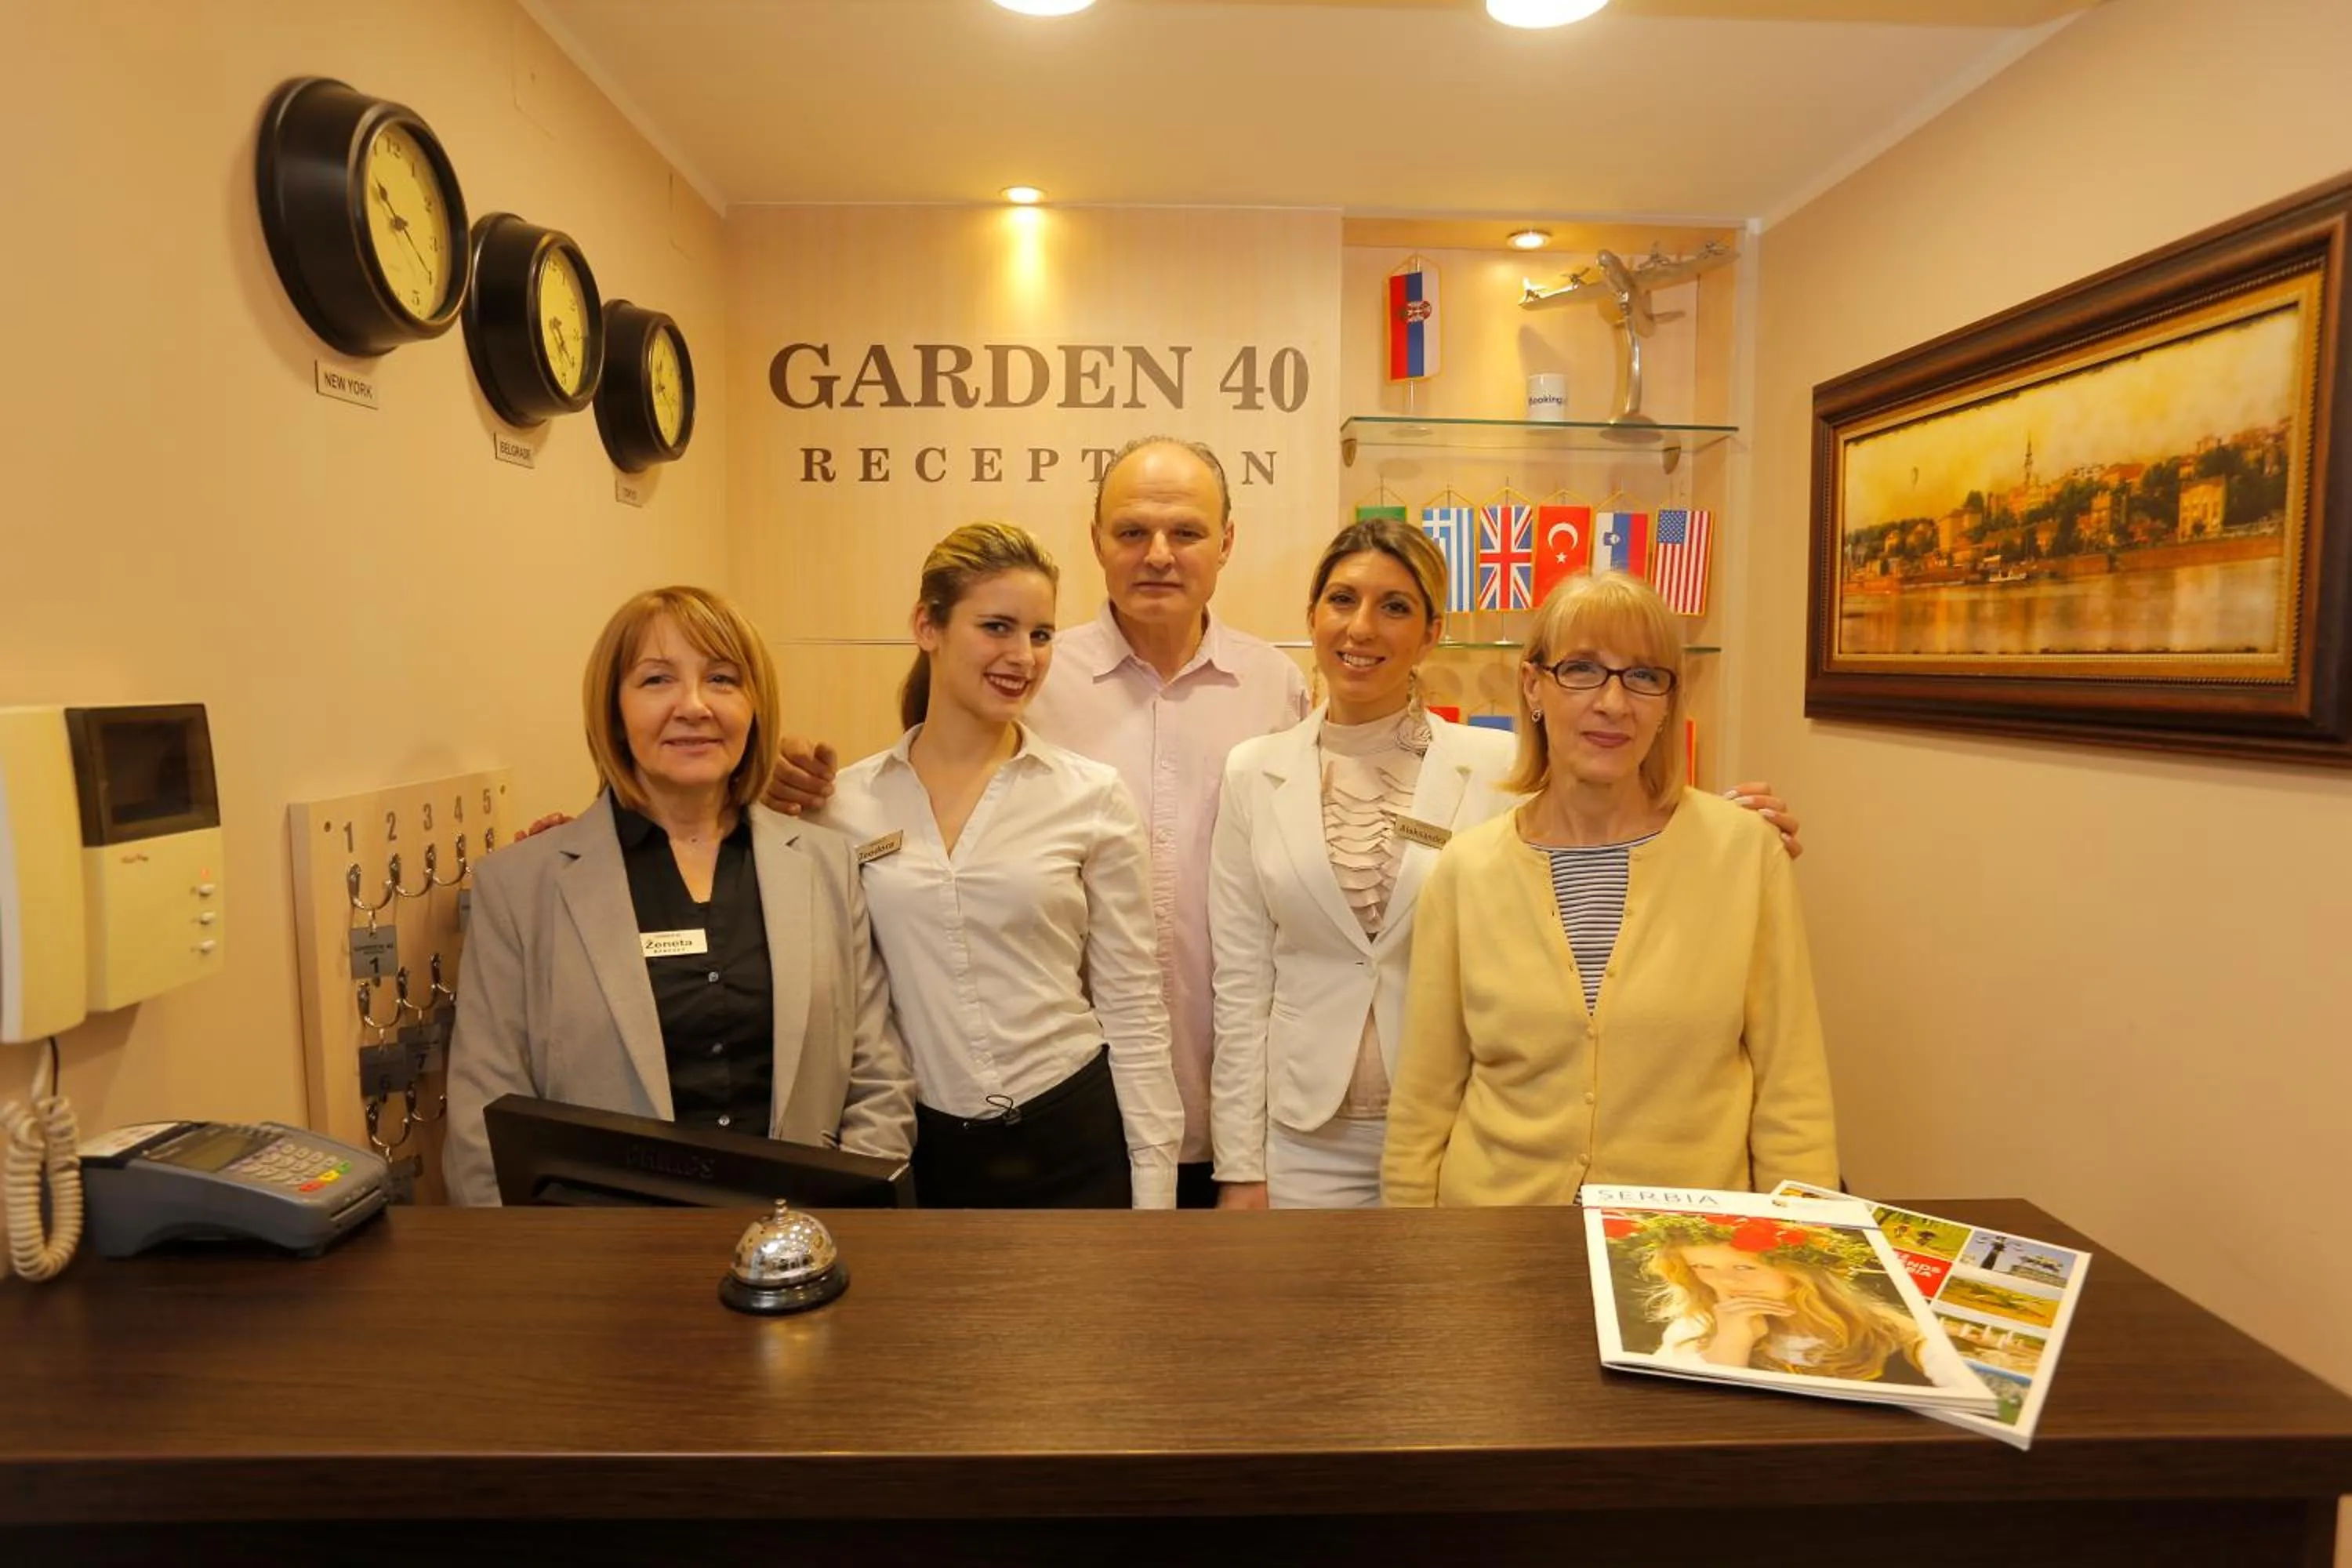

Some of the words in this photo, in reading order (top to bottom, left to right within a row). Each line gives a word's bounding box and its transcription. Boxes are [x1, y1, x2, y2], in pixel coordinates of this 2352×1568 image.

[324, 371, 346, 391] NEW
[347, 379, 373, 399] YORK
[768, 343, 1192, 411] GARDEN
[1219, 346, 1310, 413] 40
[800, 447, 1277, 485] RECEPTN
[343, 822, 354, 853] 1
[387, 811, 397, 841] 2
[423, 803, 433, 831] 3
[454, 795, 463, 822] 4
[483, 788, 492, 815] 5
[369, 956, 379, 974] 1
[1597, 1189, 1719, 1206] SERBIA
